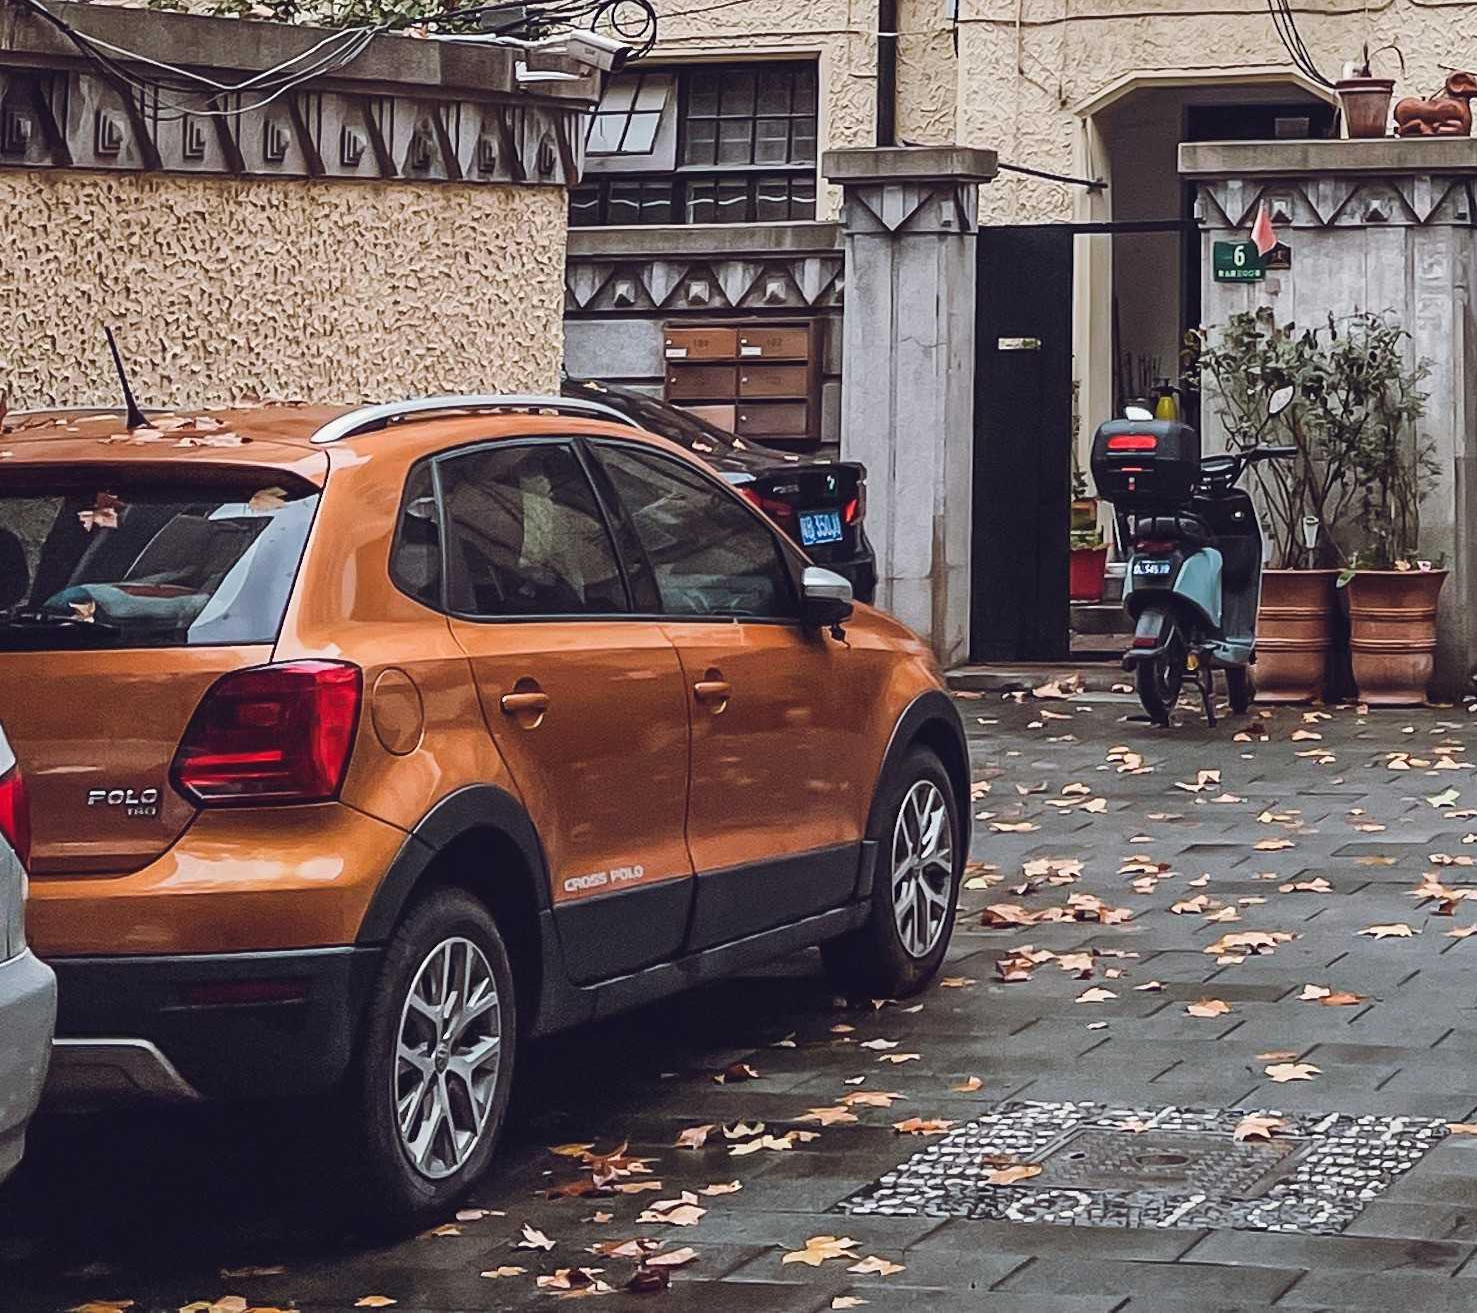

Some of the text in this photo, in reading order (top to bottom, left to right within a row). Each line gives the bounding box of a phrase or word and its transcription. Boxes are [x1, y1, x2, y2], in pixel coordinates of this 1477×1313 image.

[1233, 244, 1246, 267] 6
[87, 788, 157, 805] POLO
[564, 864, 644, 892] CROSS POLO
